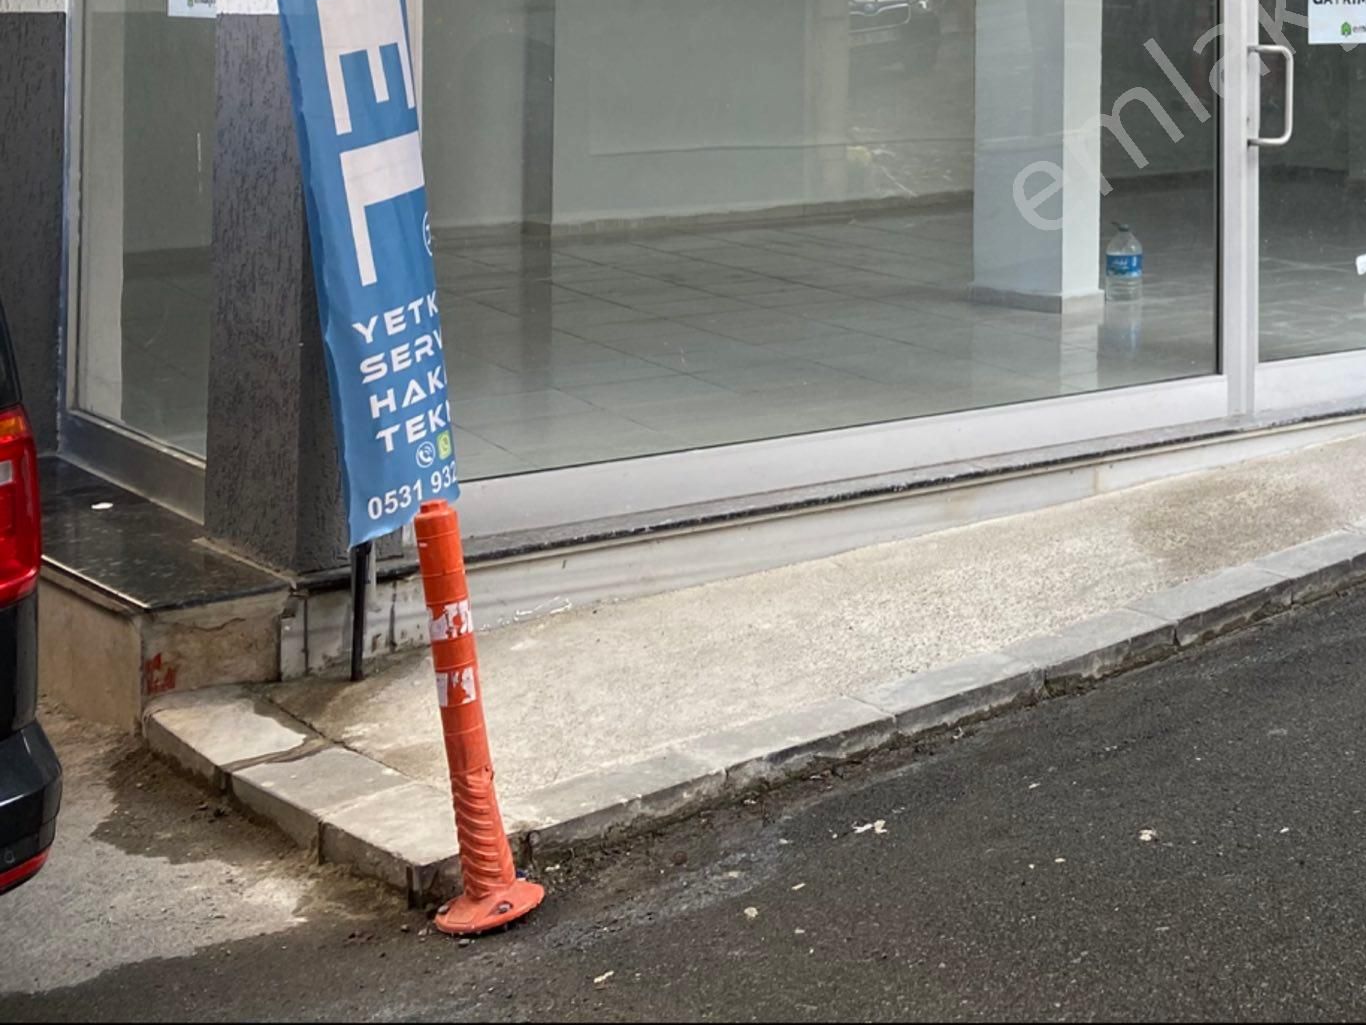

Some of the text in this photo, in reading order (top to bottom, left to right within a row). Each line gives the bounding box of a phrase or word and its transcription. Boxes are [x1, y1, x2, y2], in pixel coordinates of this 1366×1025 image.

[352, 289, 439, 344] YETK
[369, 365, 447, 419] HAK
[367, 479, 423, 520] 0531
